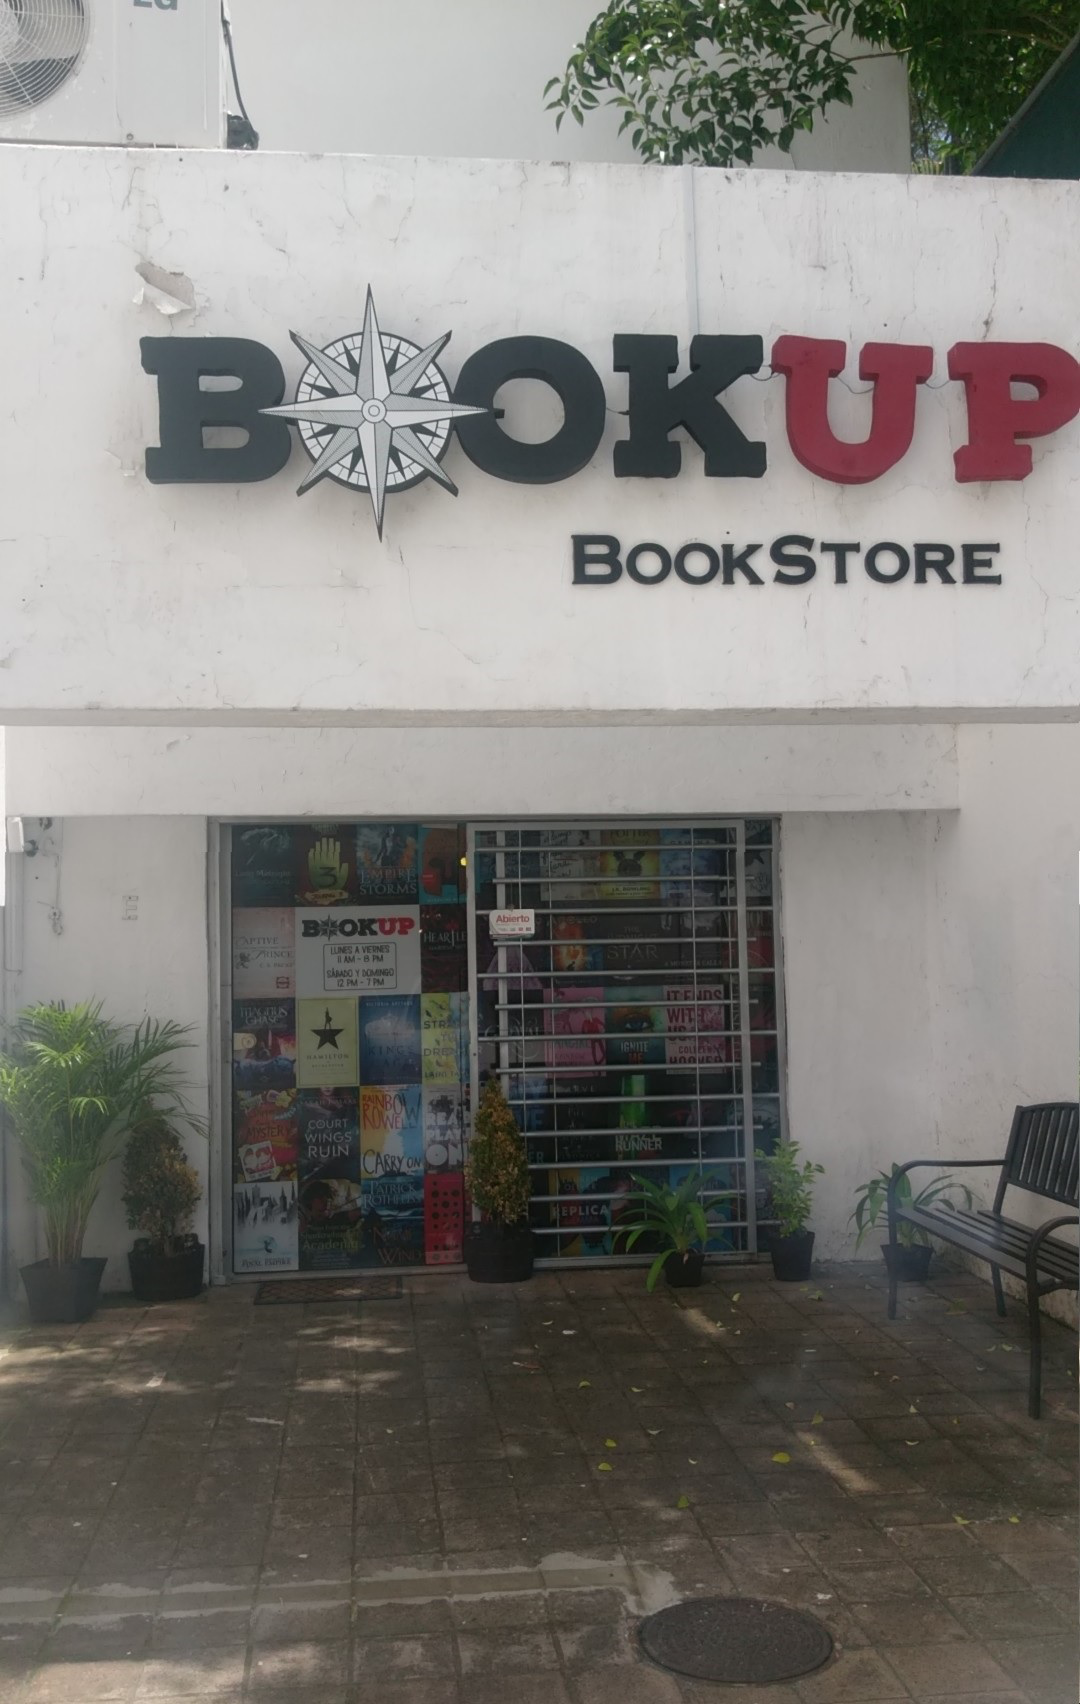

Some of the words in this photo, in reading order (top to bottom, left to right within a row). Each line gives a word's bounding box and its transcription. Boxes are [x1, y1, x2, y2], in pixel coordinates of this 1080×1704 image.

[360, 883, 416, 896] STORMS
[496, 914, 530, 924] Abierto
[330, 945, 353, 955] LUNES
[354, 946, 360, 954] A
[362, 944, 390, 954] VIERNES
[607, 944, 659, 960] STAR
[343, 955, 355, 964] AM
[372, 954, 384, 963] PM
[355, 968, 361, 977] Y
[362, 967, 395, 977] DOMINGO
[336, 978, 344, 987] 12
[346, 978, 358, 987] PM
[366, 978, 371, 987] 7
[372, 977, 384, 987] PM
[666, 990, 678, 1003] IT
[620, 1040, 649, 1053] IGNITE
[362, 1092, 422, 1123] RAINBOW
[362, 1103, 418, 1131] ROWELL
[308, 1118, 349, 1130] COURT
[304, 1131, 352, 1144] WINGS
[308, 1145, 349, 1158] RUIN
[615, 1138, 663, 1152] RUNNER
[362, 1148, 404, 1175] CARRY
[406, 1156, 421, 1169] ON
[370, 1181, 417, 1196] PATRICK
[552, 1205, 607, 1217] REPLICA
